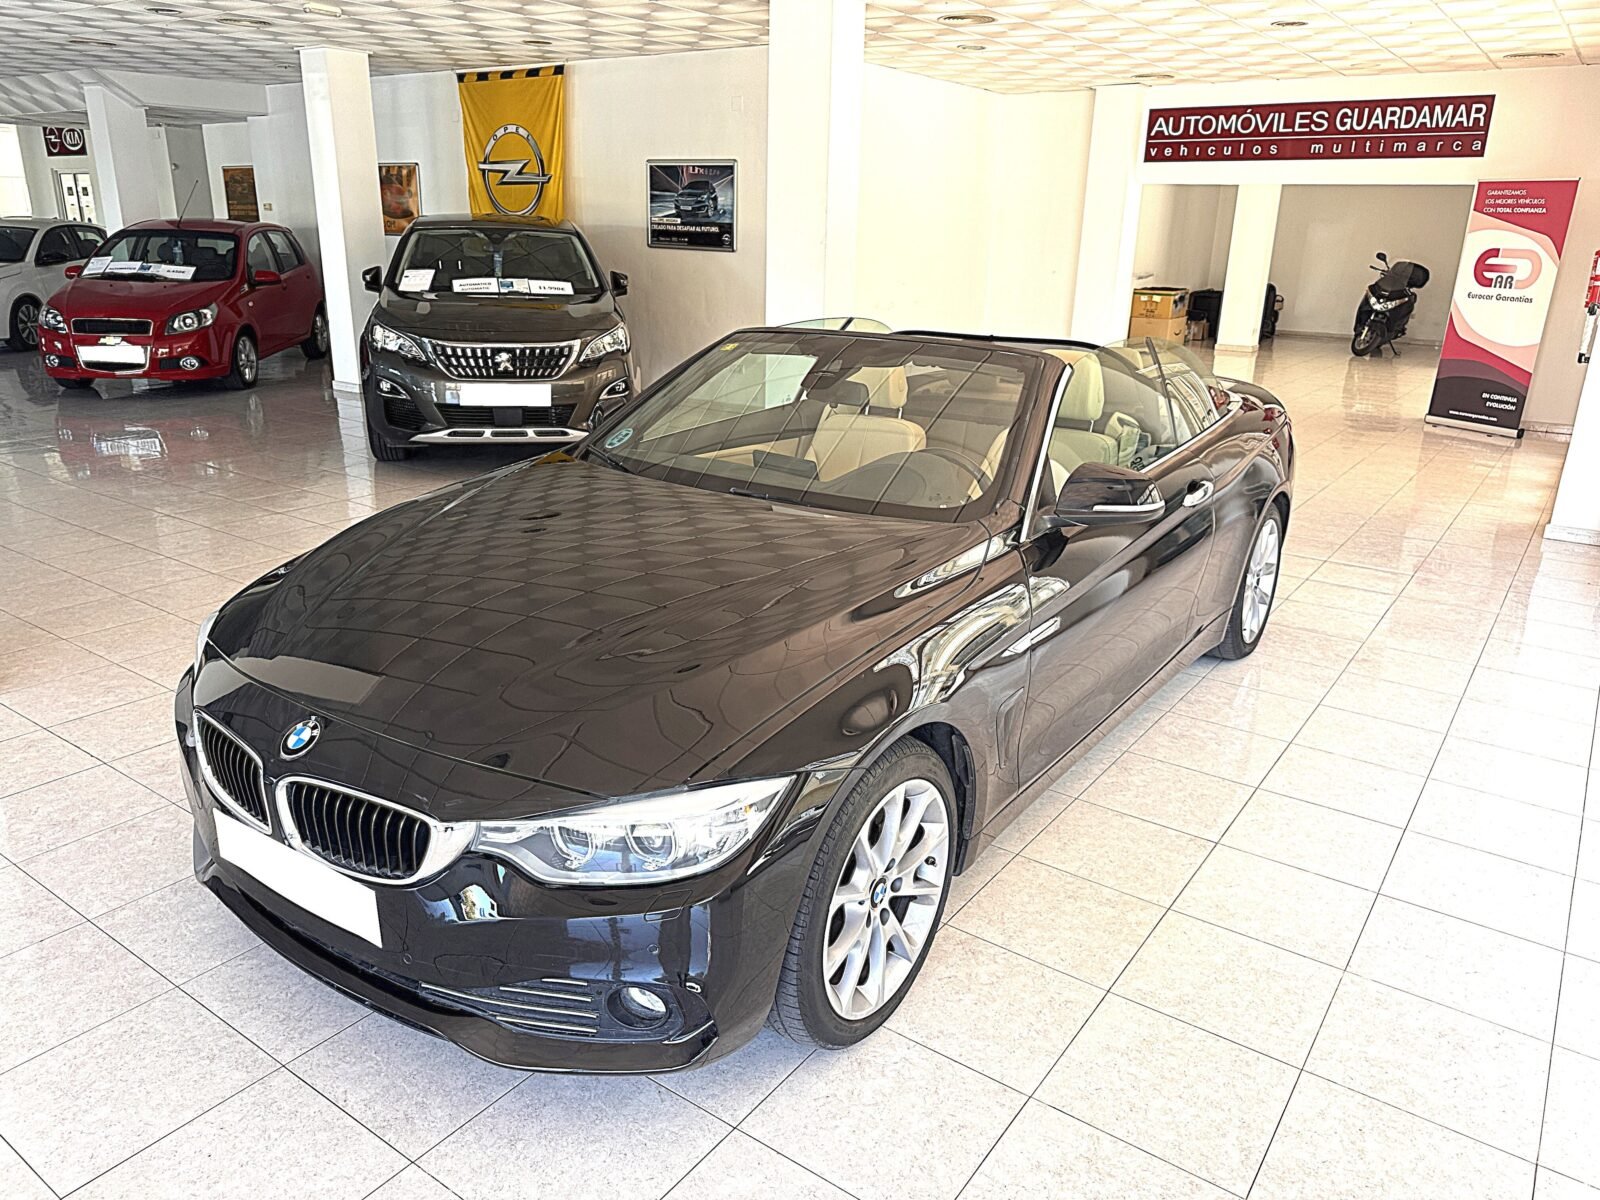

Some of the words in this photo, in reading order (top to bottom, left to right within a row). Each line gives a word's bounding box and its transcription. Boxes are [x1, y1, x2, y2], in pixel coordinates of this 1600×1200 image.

[1150, 108, 1329, 137] AUTOMÓVILES
[1335, 103, 1487, 131] GUARDAMAR
[65, 131, 81, 145] KIA
[492, 126, 532, 142] OPEL
[1310, 140, 1482, 154] multimarca
[1467, 291, 1494, 300] Eurocar
[1490, 393, 1518, 403] CONTINUA
[1485, 401, 1516, 411] EVOLUCIÓN
